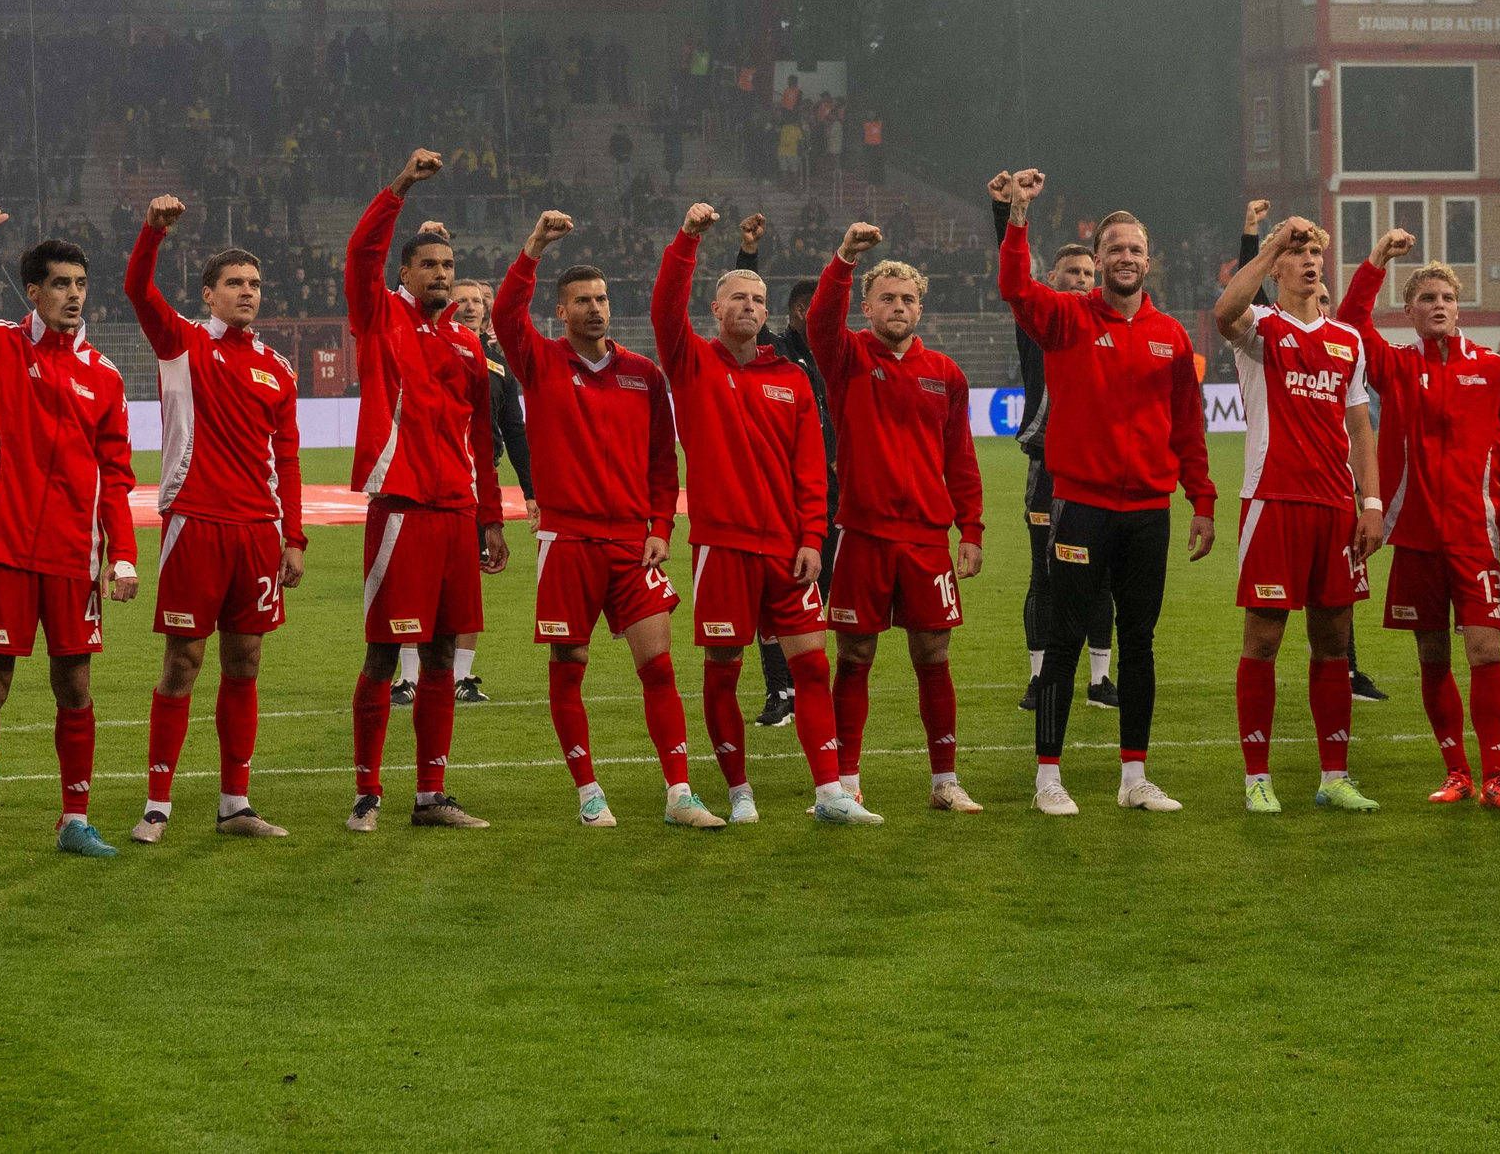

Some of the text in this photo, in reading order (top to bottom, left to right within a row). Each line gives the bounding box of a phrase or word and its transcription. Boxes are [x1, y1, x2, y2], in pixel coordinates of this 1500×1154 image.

[318, 350, 336, 362] Tor
[321, 366, 335, 378] 13
[1285, 370, 1344, 394] proAF
[1291, 387, 1308, 397] ALTE
[933, 570, 957, 609] 16
[84, 589, 101, 627] 4
